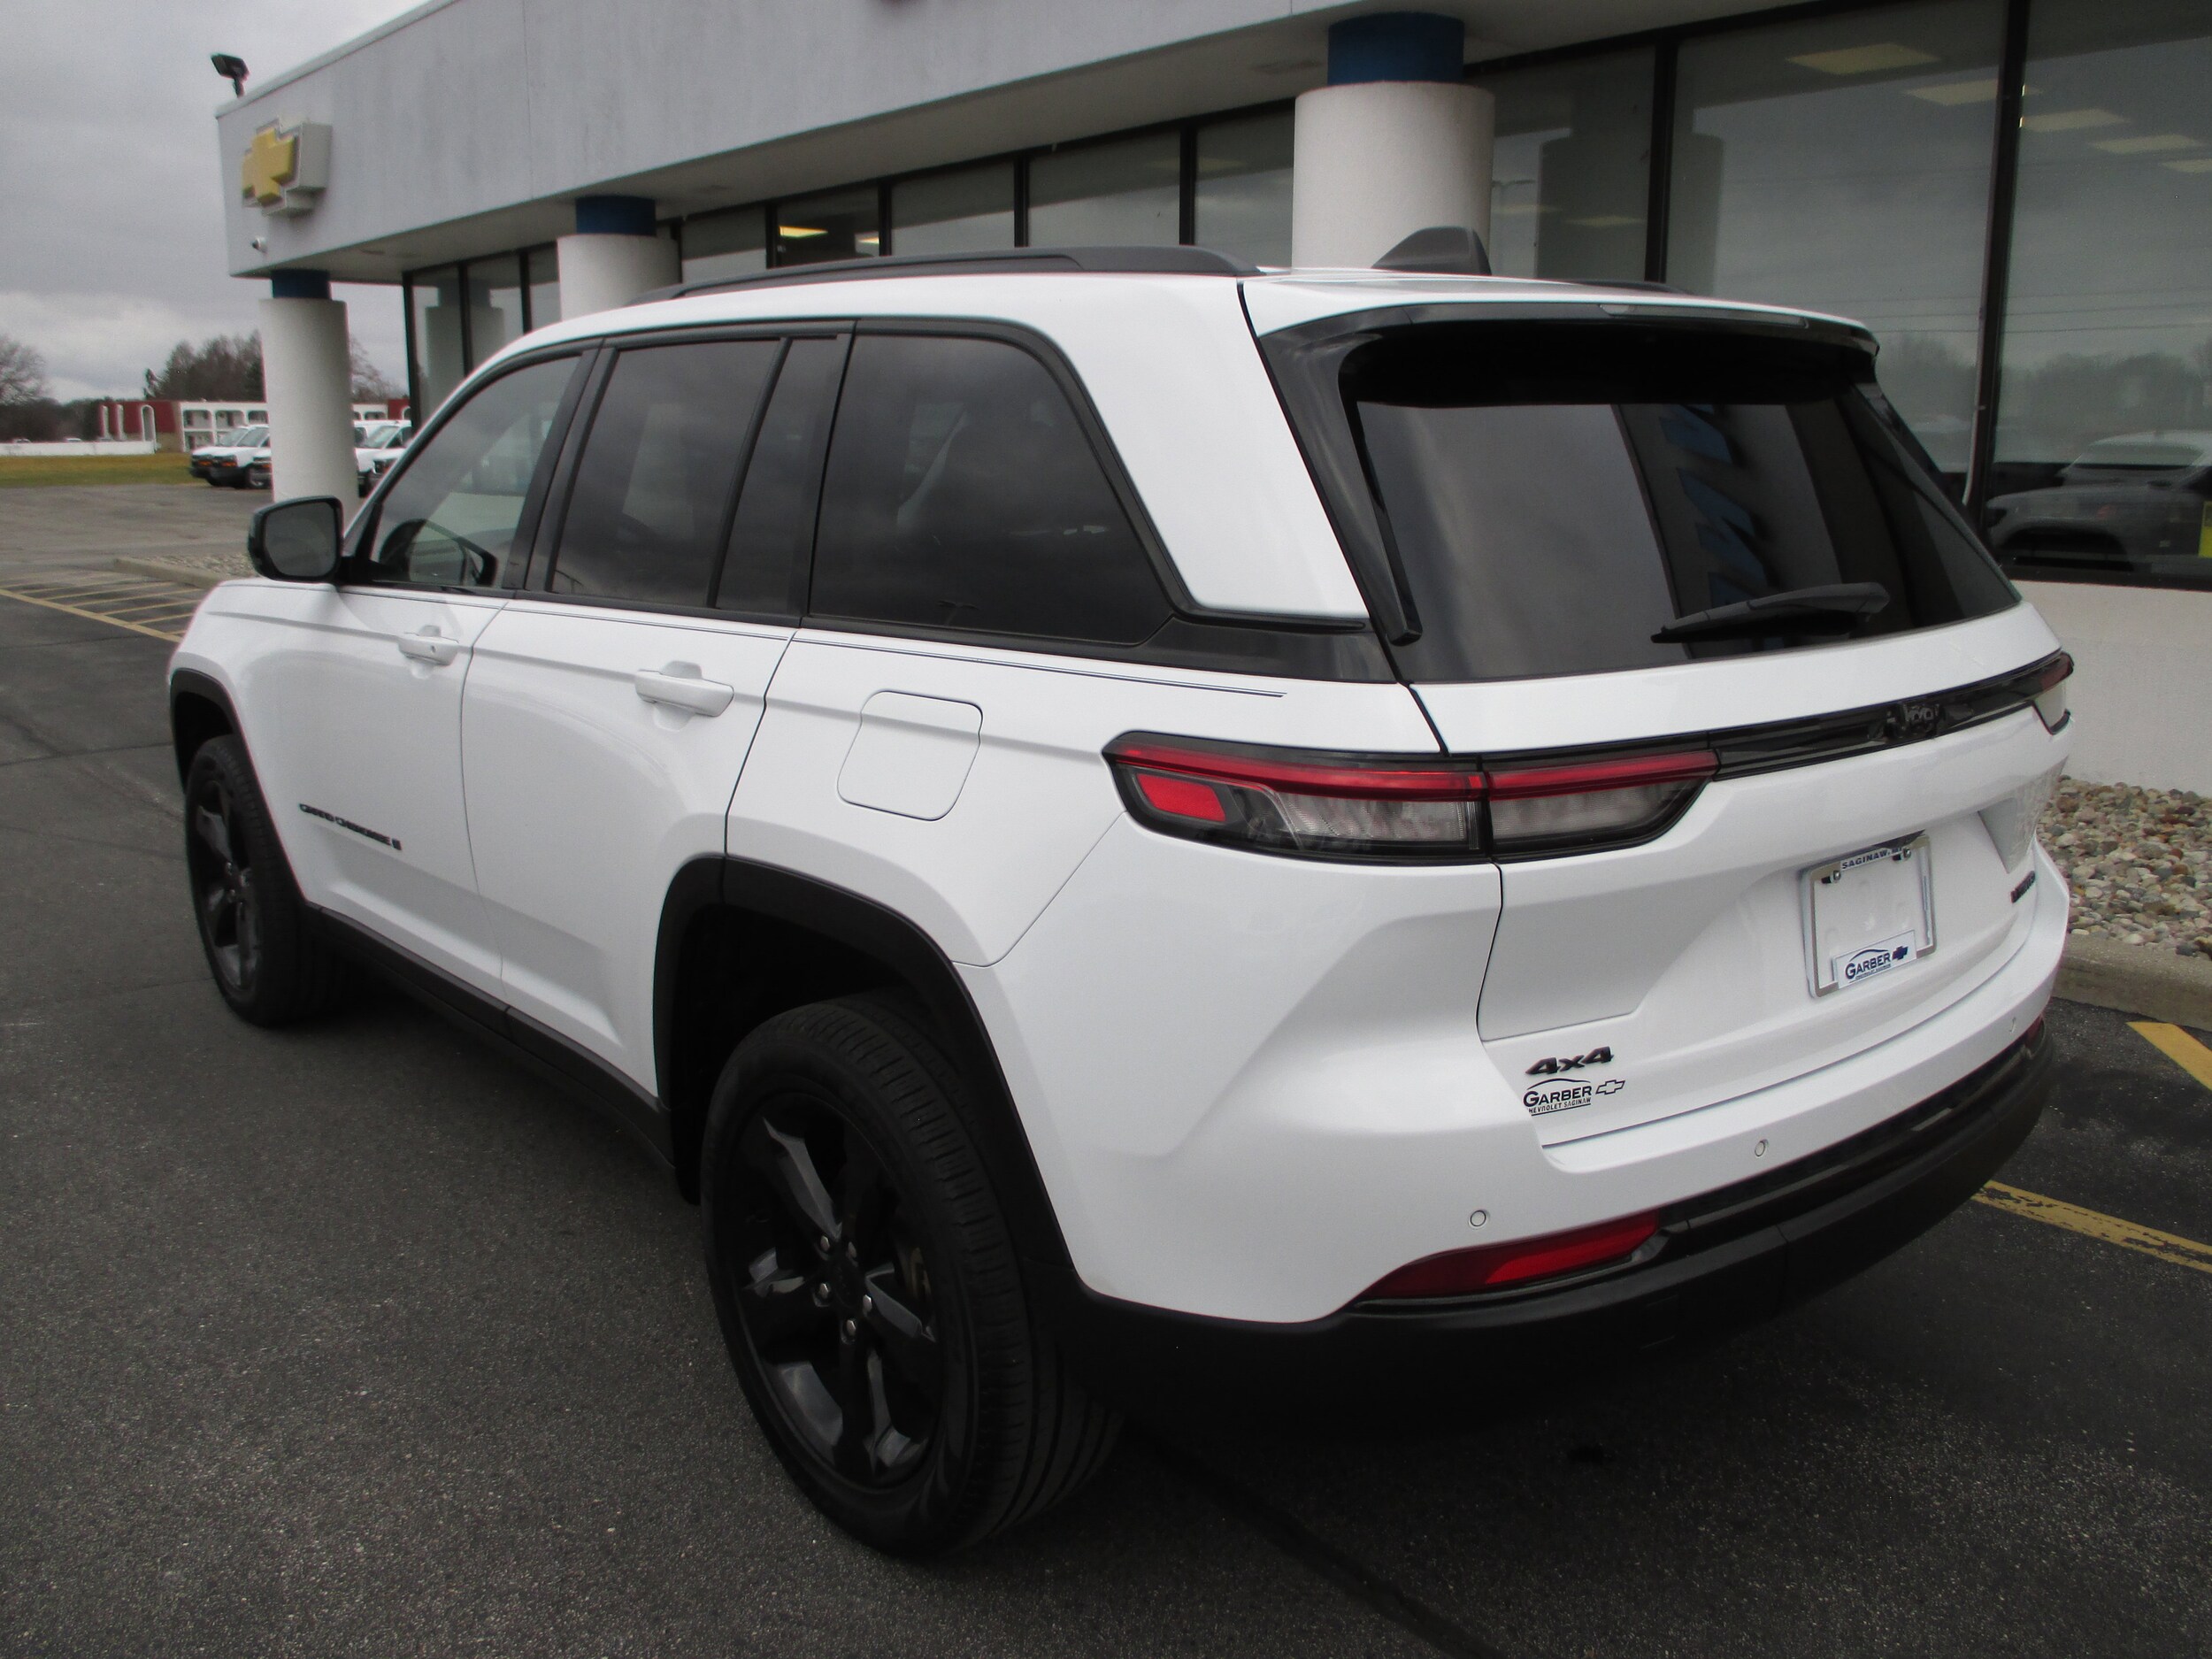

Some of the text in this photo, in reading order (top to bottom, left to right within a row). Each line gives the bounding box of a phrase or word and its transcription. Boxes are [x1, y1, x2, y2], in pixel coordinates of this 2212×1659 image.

[1845, 952, 1891, 979] GARBER
[1523, 1086, 1593, 1108] GARBER
[1526, 1097, 1592, 1114] HEVROLET SAGINAW
